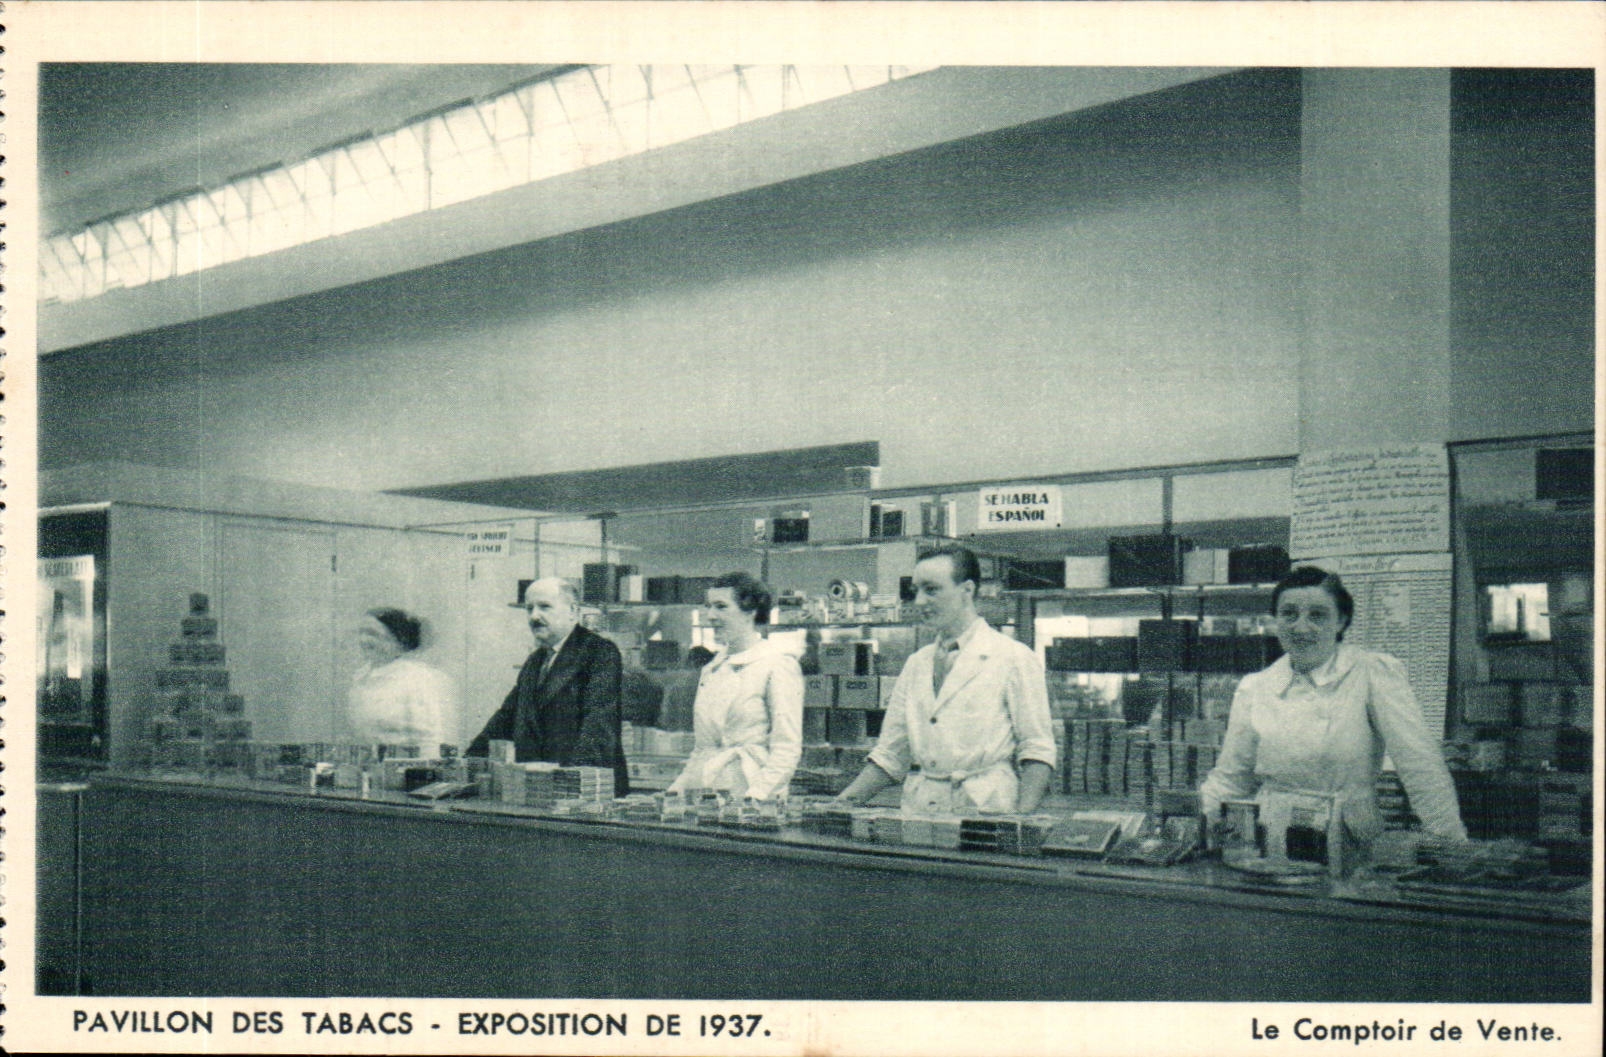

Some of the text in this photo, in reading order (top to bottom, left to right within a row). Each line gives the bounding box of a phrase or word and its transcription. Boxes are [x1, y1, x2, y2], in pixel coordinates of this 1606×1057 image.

[984, 491, 1049, 506] SE HABLA
[988, 506, 1046, 522] ESPAÑOL
